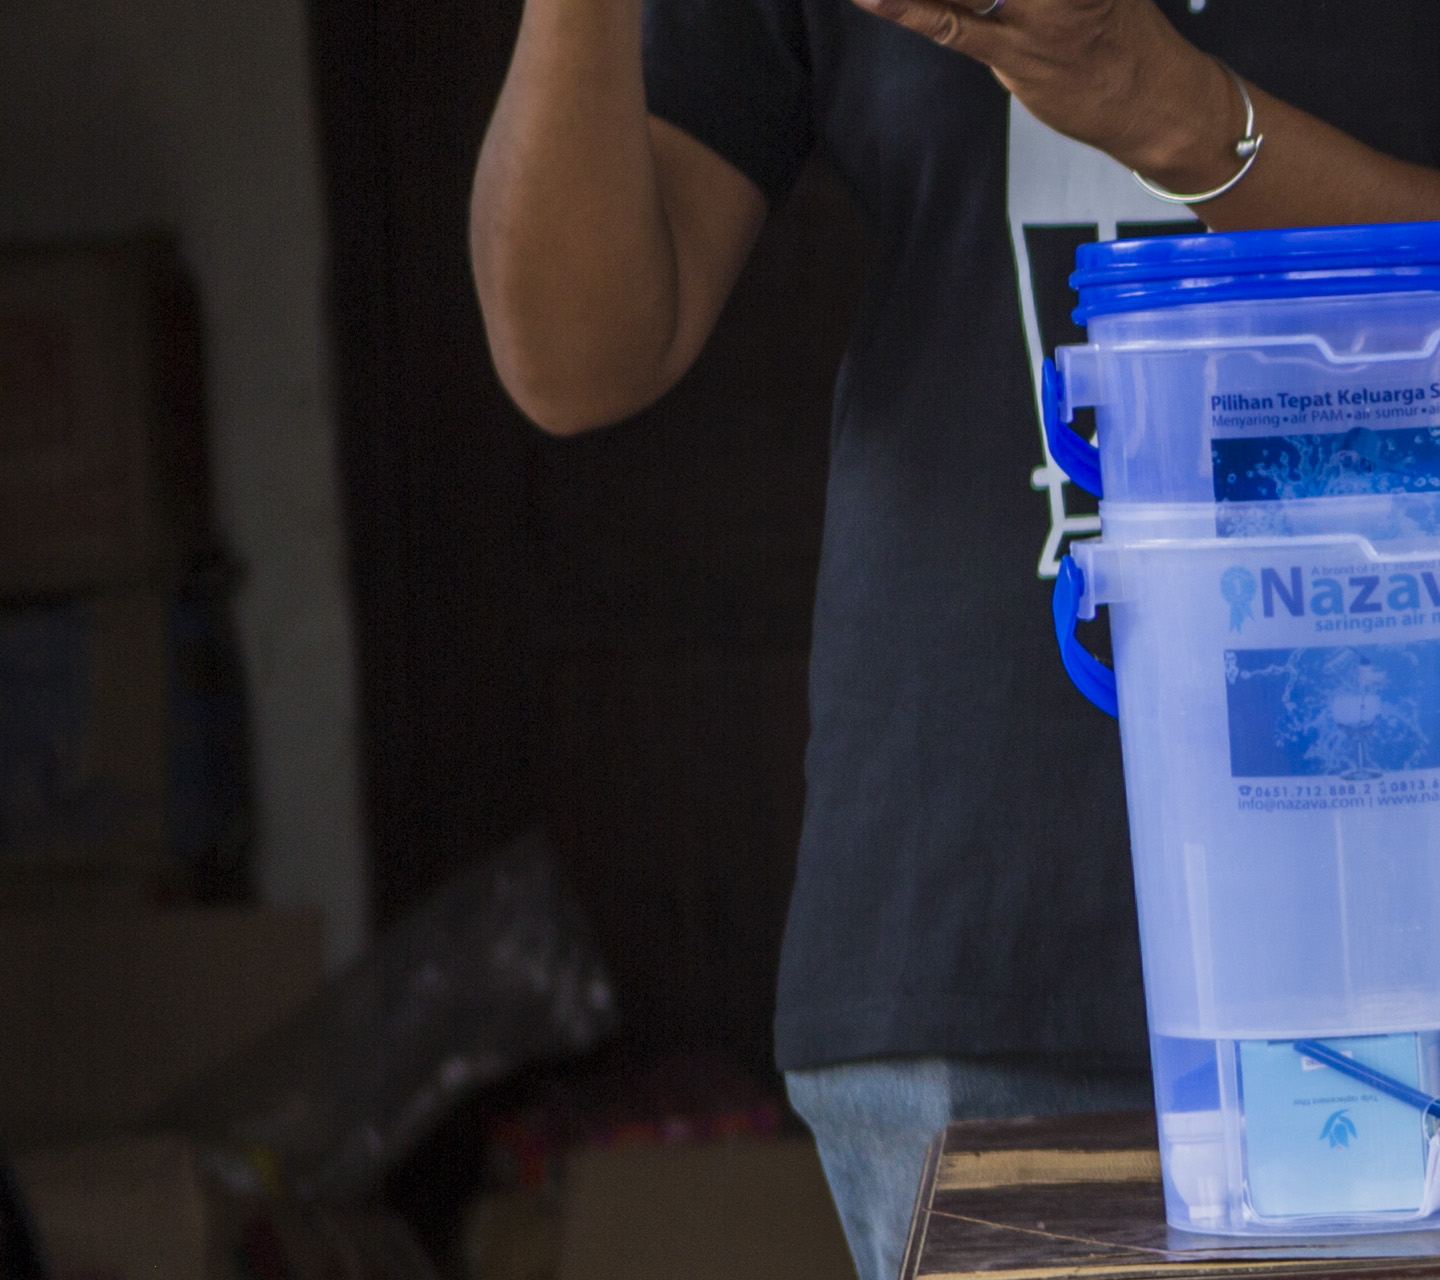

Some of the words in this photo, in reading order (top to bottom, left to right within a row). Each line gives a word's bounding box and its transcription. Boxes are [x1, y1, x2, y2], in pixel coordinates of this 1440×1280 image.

[1211, 392, 1273, 411] Pilihan
[1276, 392, 1332, 411] Tepat
[1338, 387, 1425, 405] Keluarga
[1212, 414, 1280, 428] Menyaring
[1290, 413, 1307, 424] air
[1311, 409, 1343, 422] PAM
[1353, 409, 1371, 420] air
[1375, 407, 1418, 419] sumur
[1315, 615, 1396, 633] saringan
[1402, 612, 1425, 626] air
